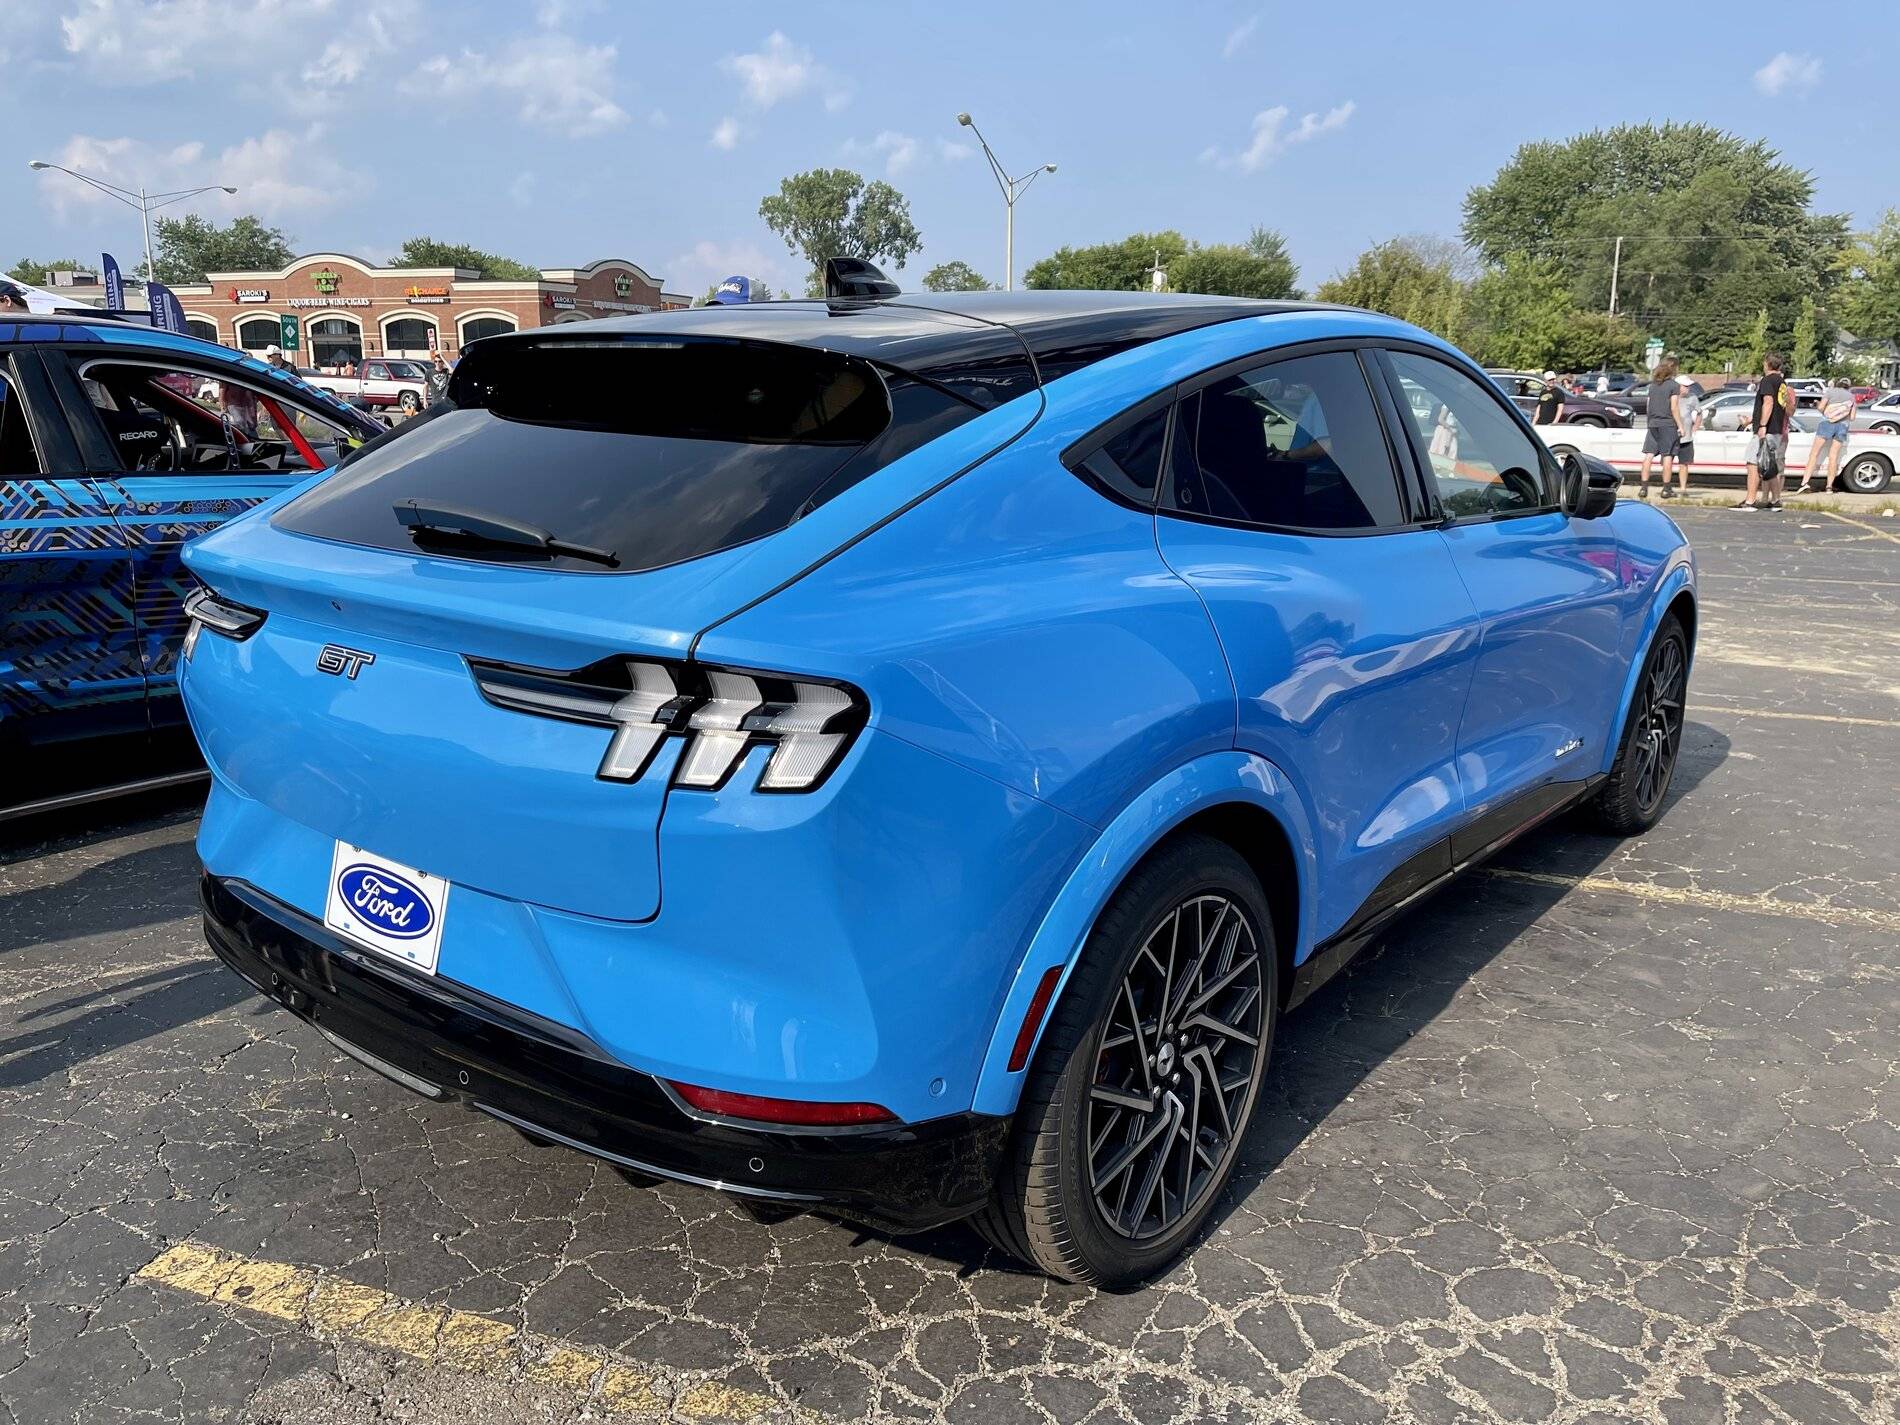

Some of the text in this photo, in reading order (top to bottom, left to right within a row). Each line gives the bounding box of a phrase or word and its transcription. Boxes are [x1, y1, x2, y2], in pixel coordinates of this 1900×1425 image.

[119, 430, 158, 441] RECARO
[316, 643, 376, 680] GT
[354, 874, 415, 927] Ford
